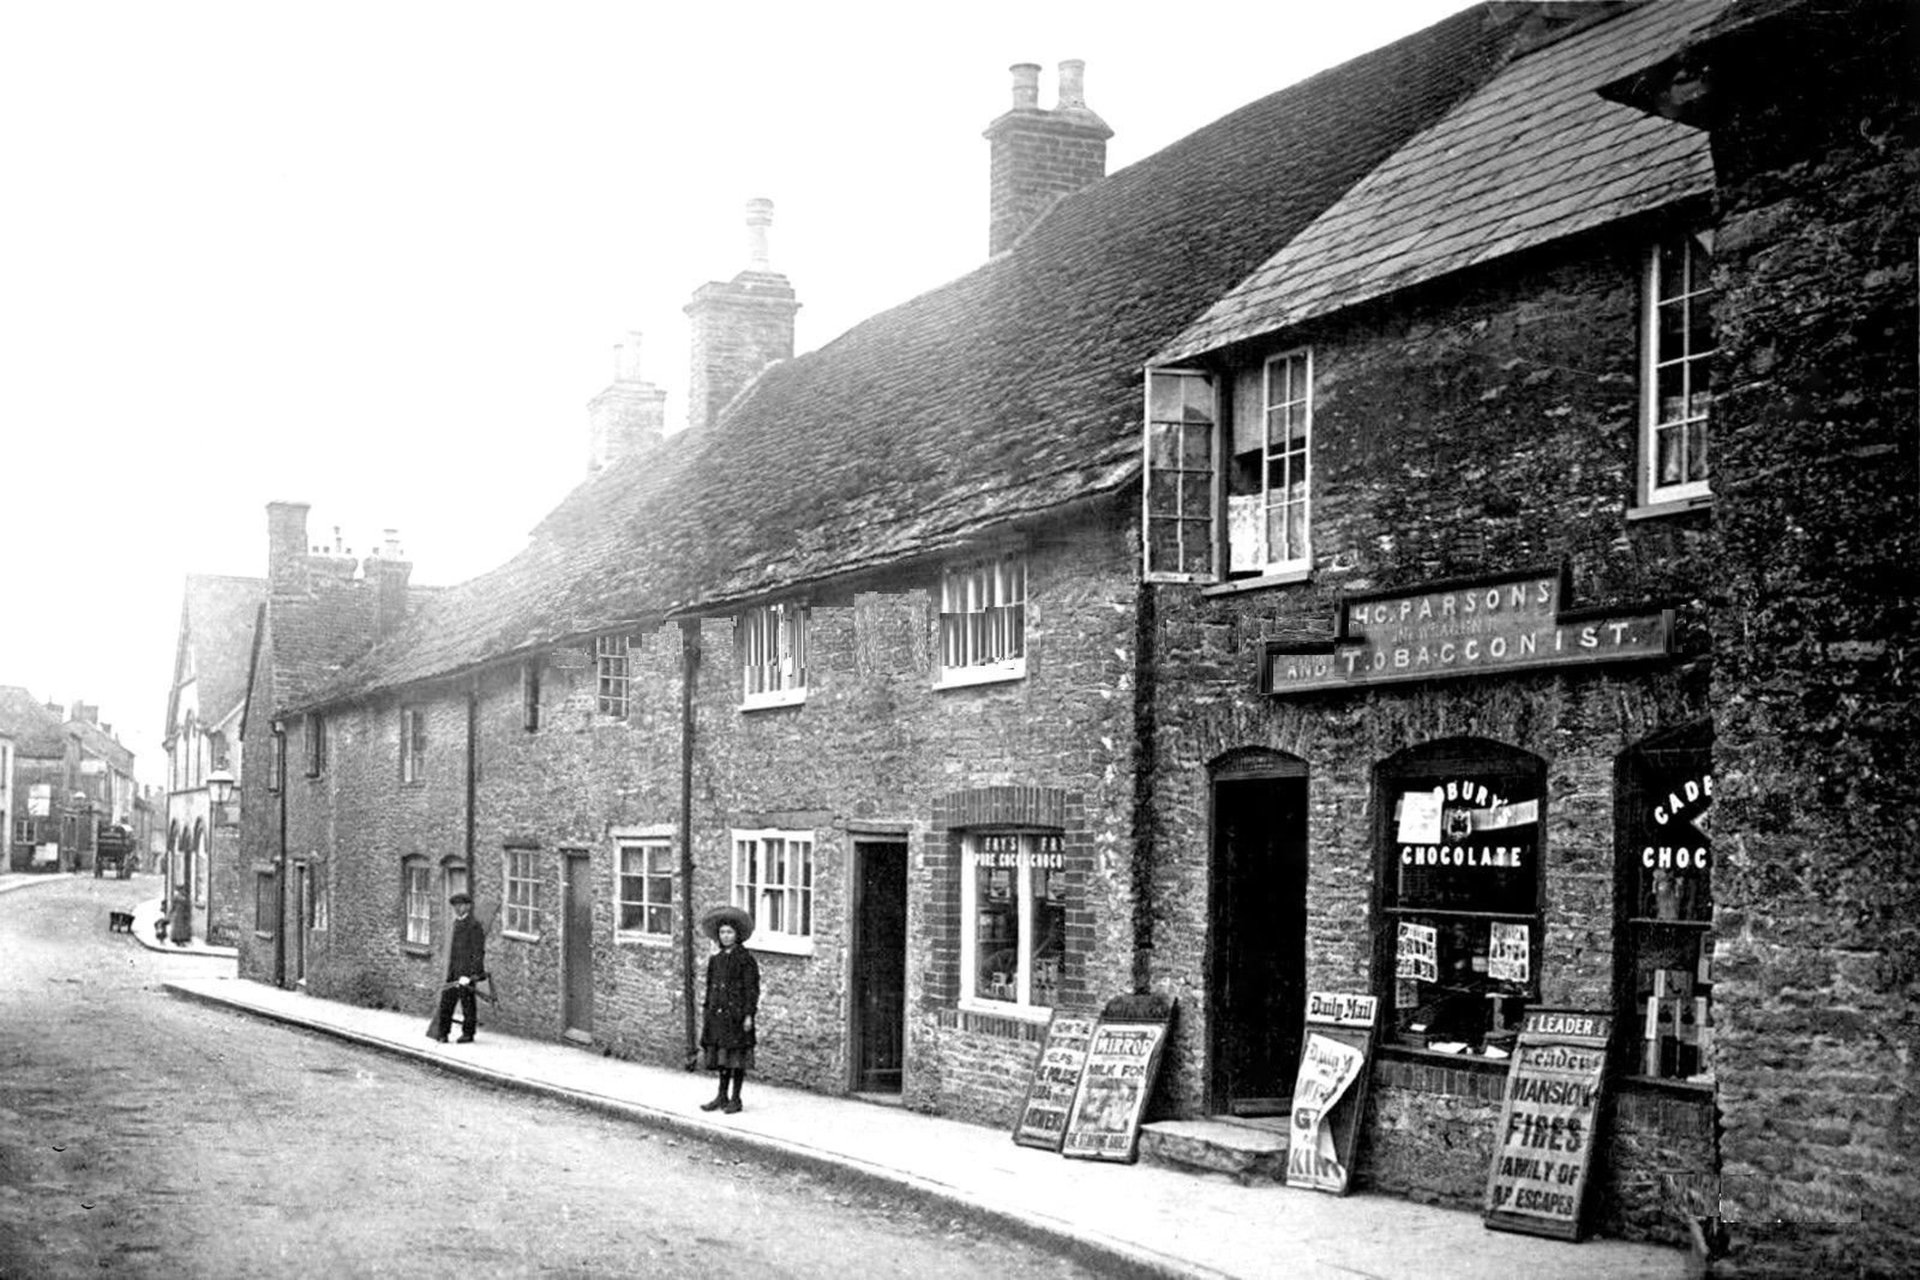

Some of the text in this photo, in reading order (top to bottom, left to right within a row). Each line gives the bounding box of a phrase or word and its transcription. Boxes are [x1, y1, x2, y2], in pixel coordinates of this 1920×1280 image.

[1400, 581, 1550, 621] PARSONS
[1402, 846, 1521, 867] CHOCOLATE
[1311, 995, 1374, 1021] Daily Mail
[1540, 1015, 1593, 1036] LEADER
[1504, 1111, 1584, 1153] FIRES
[1556, 1162, 1581, 1187] OF
[1514, 1187, 1575, 1217] ESCAPES
